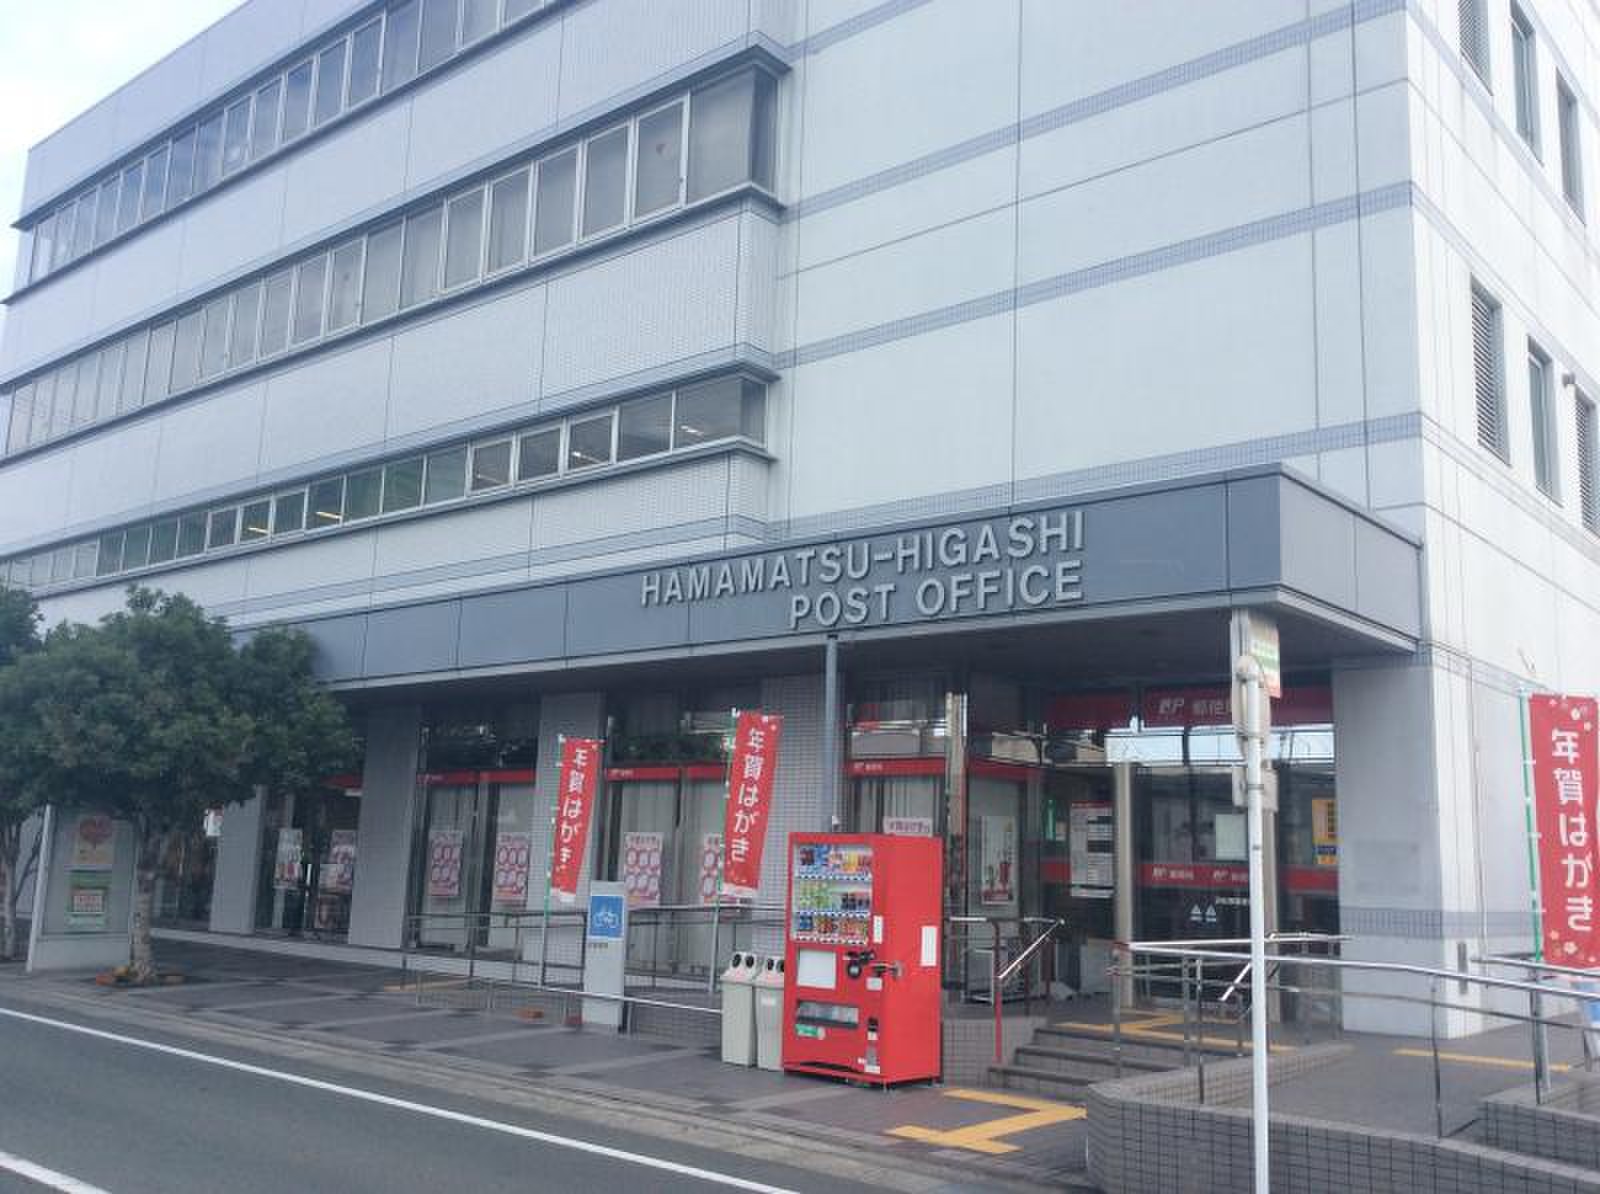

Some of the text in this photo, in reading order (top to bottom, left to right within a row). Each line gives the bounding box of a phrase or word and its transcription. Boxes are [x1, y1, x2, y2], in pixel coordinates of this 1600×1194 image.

[641, 511, 1085, 608] HAMAMATSU-HIGASHI
[790, 559, 1084, 631] POST OFFICE
[559, 748, 588, 863] 年賀はがき
[730, 727, 765, 863] 年賀はがき
[1551, 729, 1593, 931] 年賀はがき
